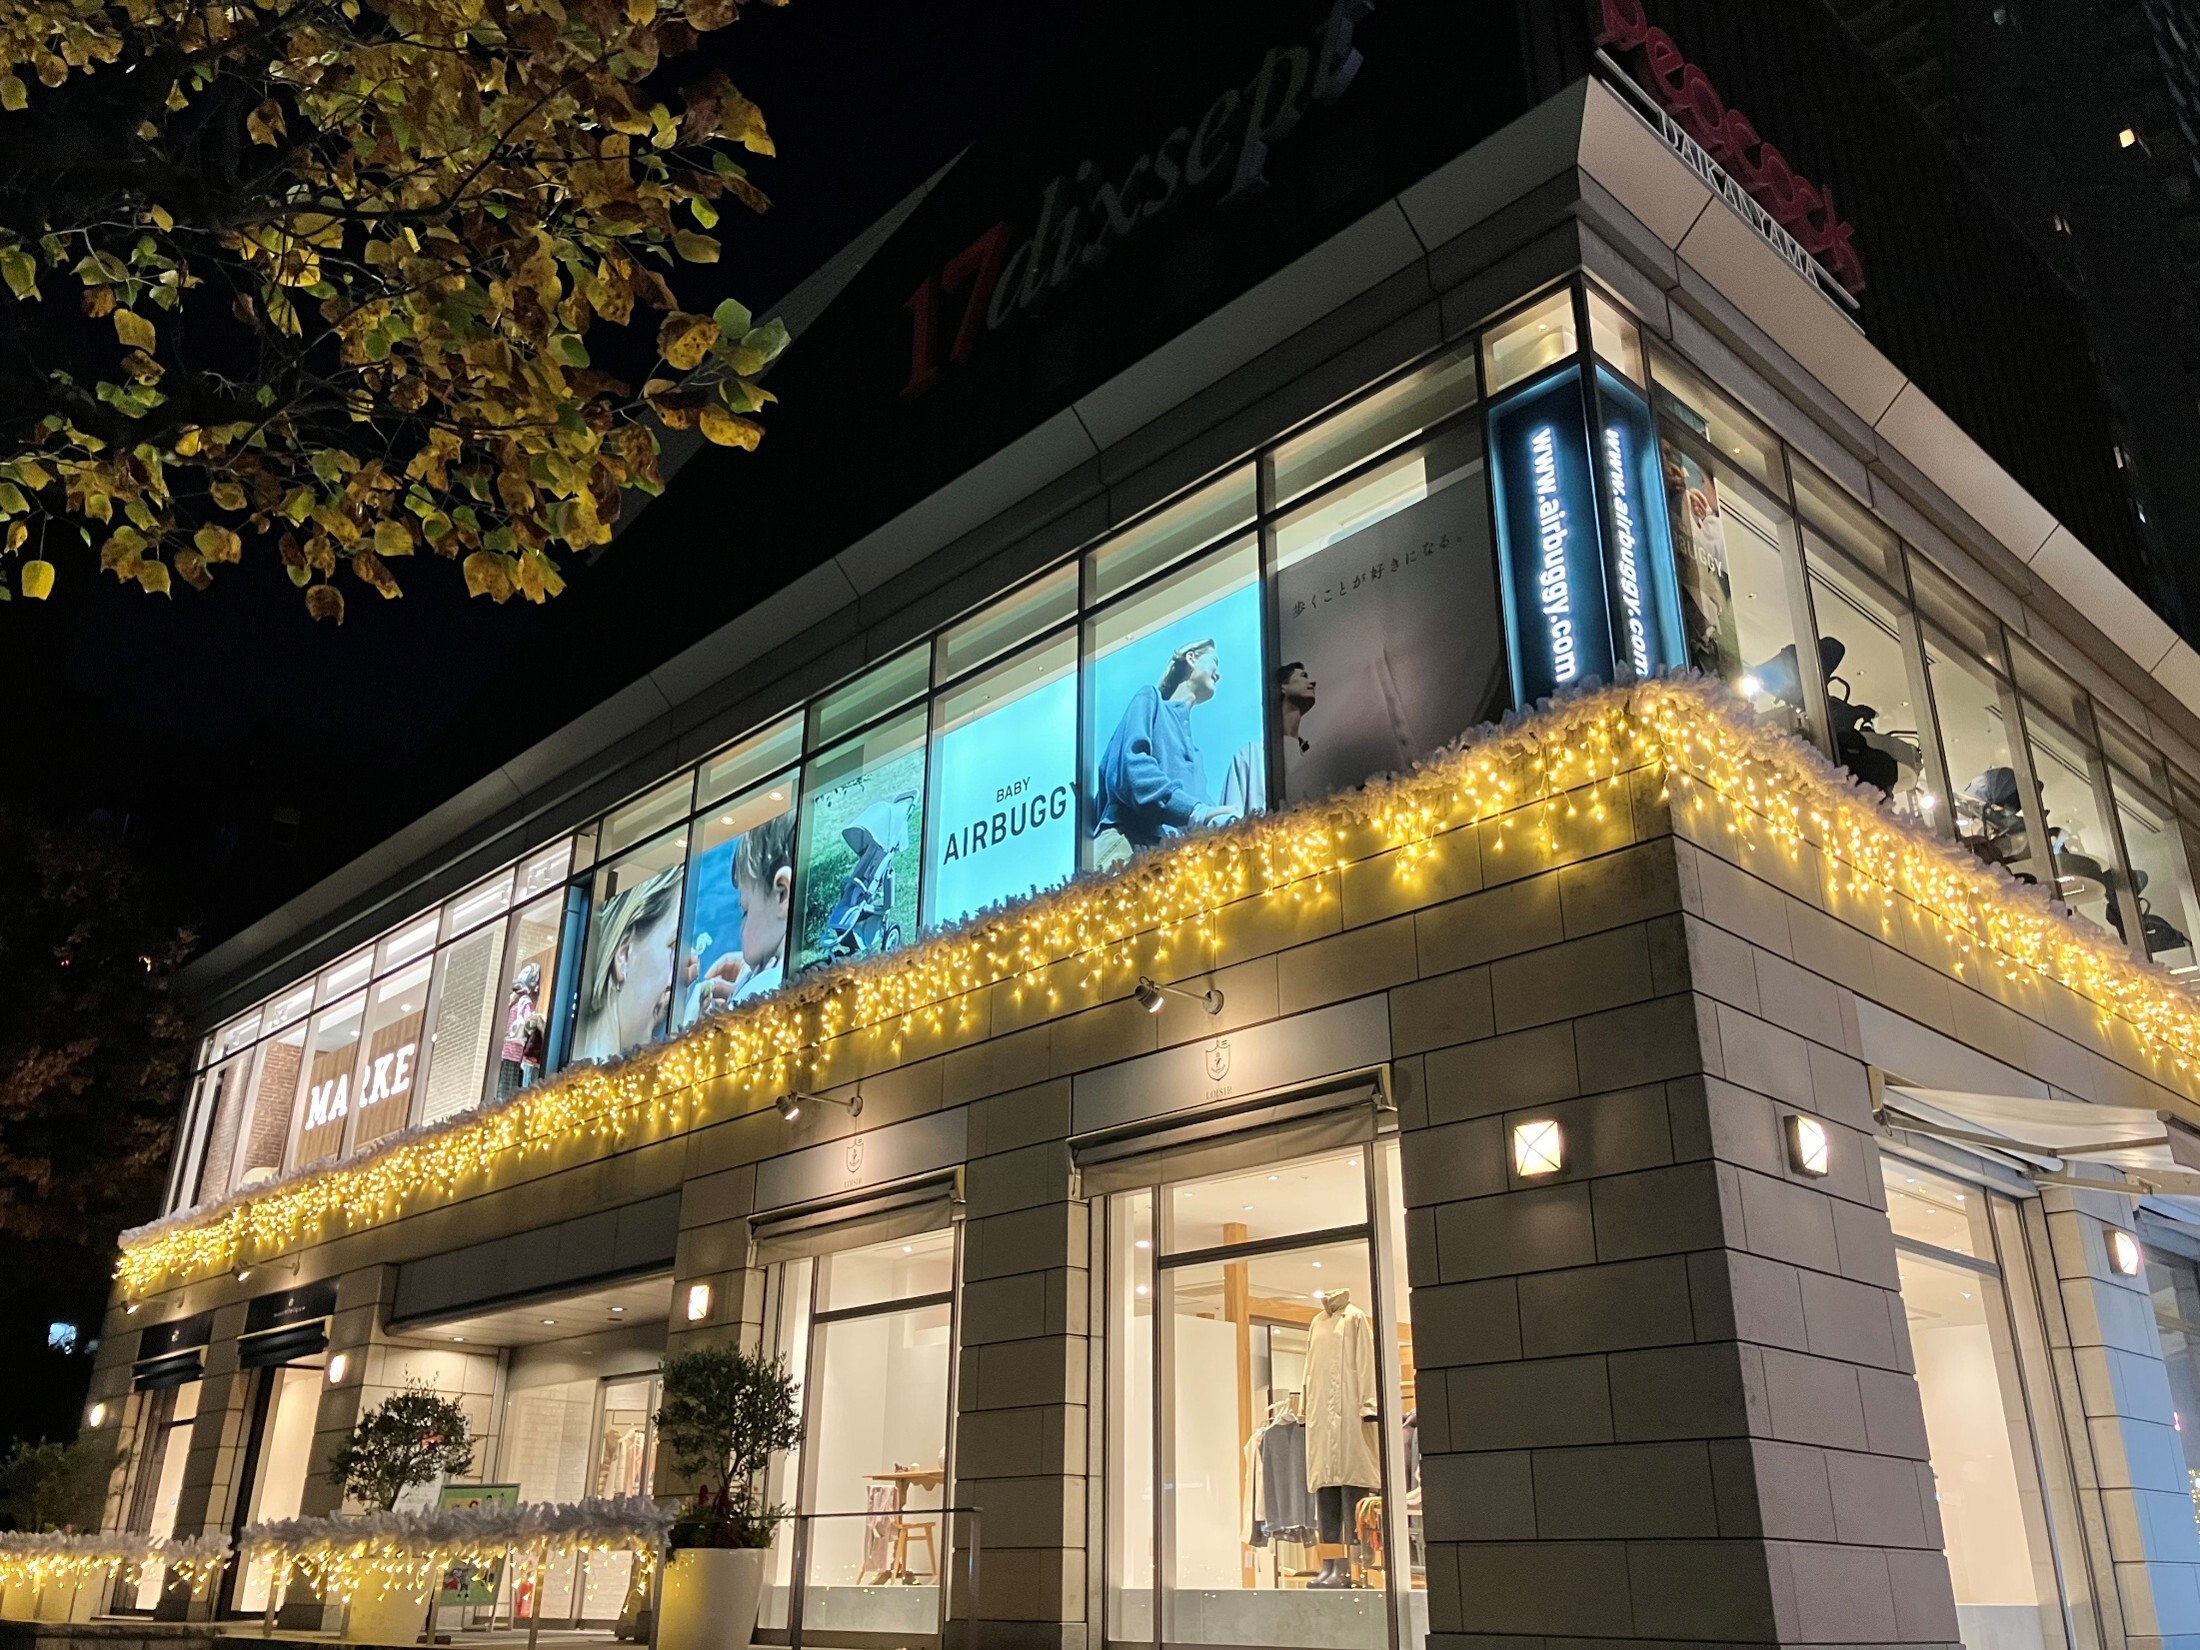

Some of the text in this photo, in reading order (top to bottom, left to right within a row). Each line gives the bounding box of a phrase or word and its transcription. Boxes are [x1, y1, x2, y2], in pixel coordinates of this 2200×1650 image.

[1657, 109, 1819, 288] DAIKANYAMA
[1531, 427, 1578, 683] www.airbuggy.com
[996, 776, 1031, 803] BABY
[1205, 1086, 1233, 1100] LOISIR
